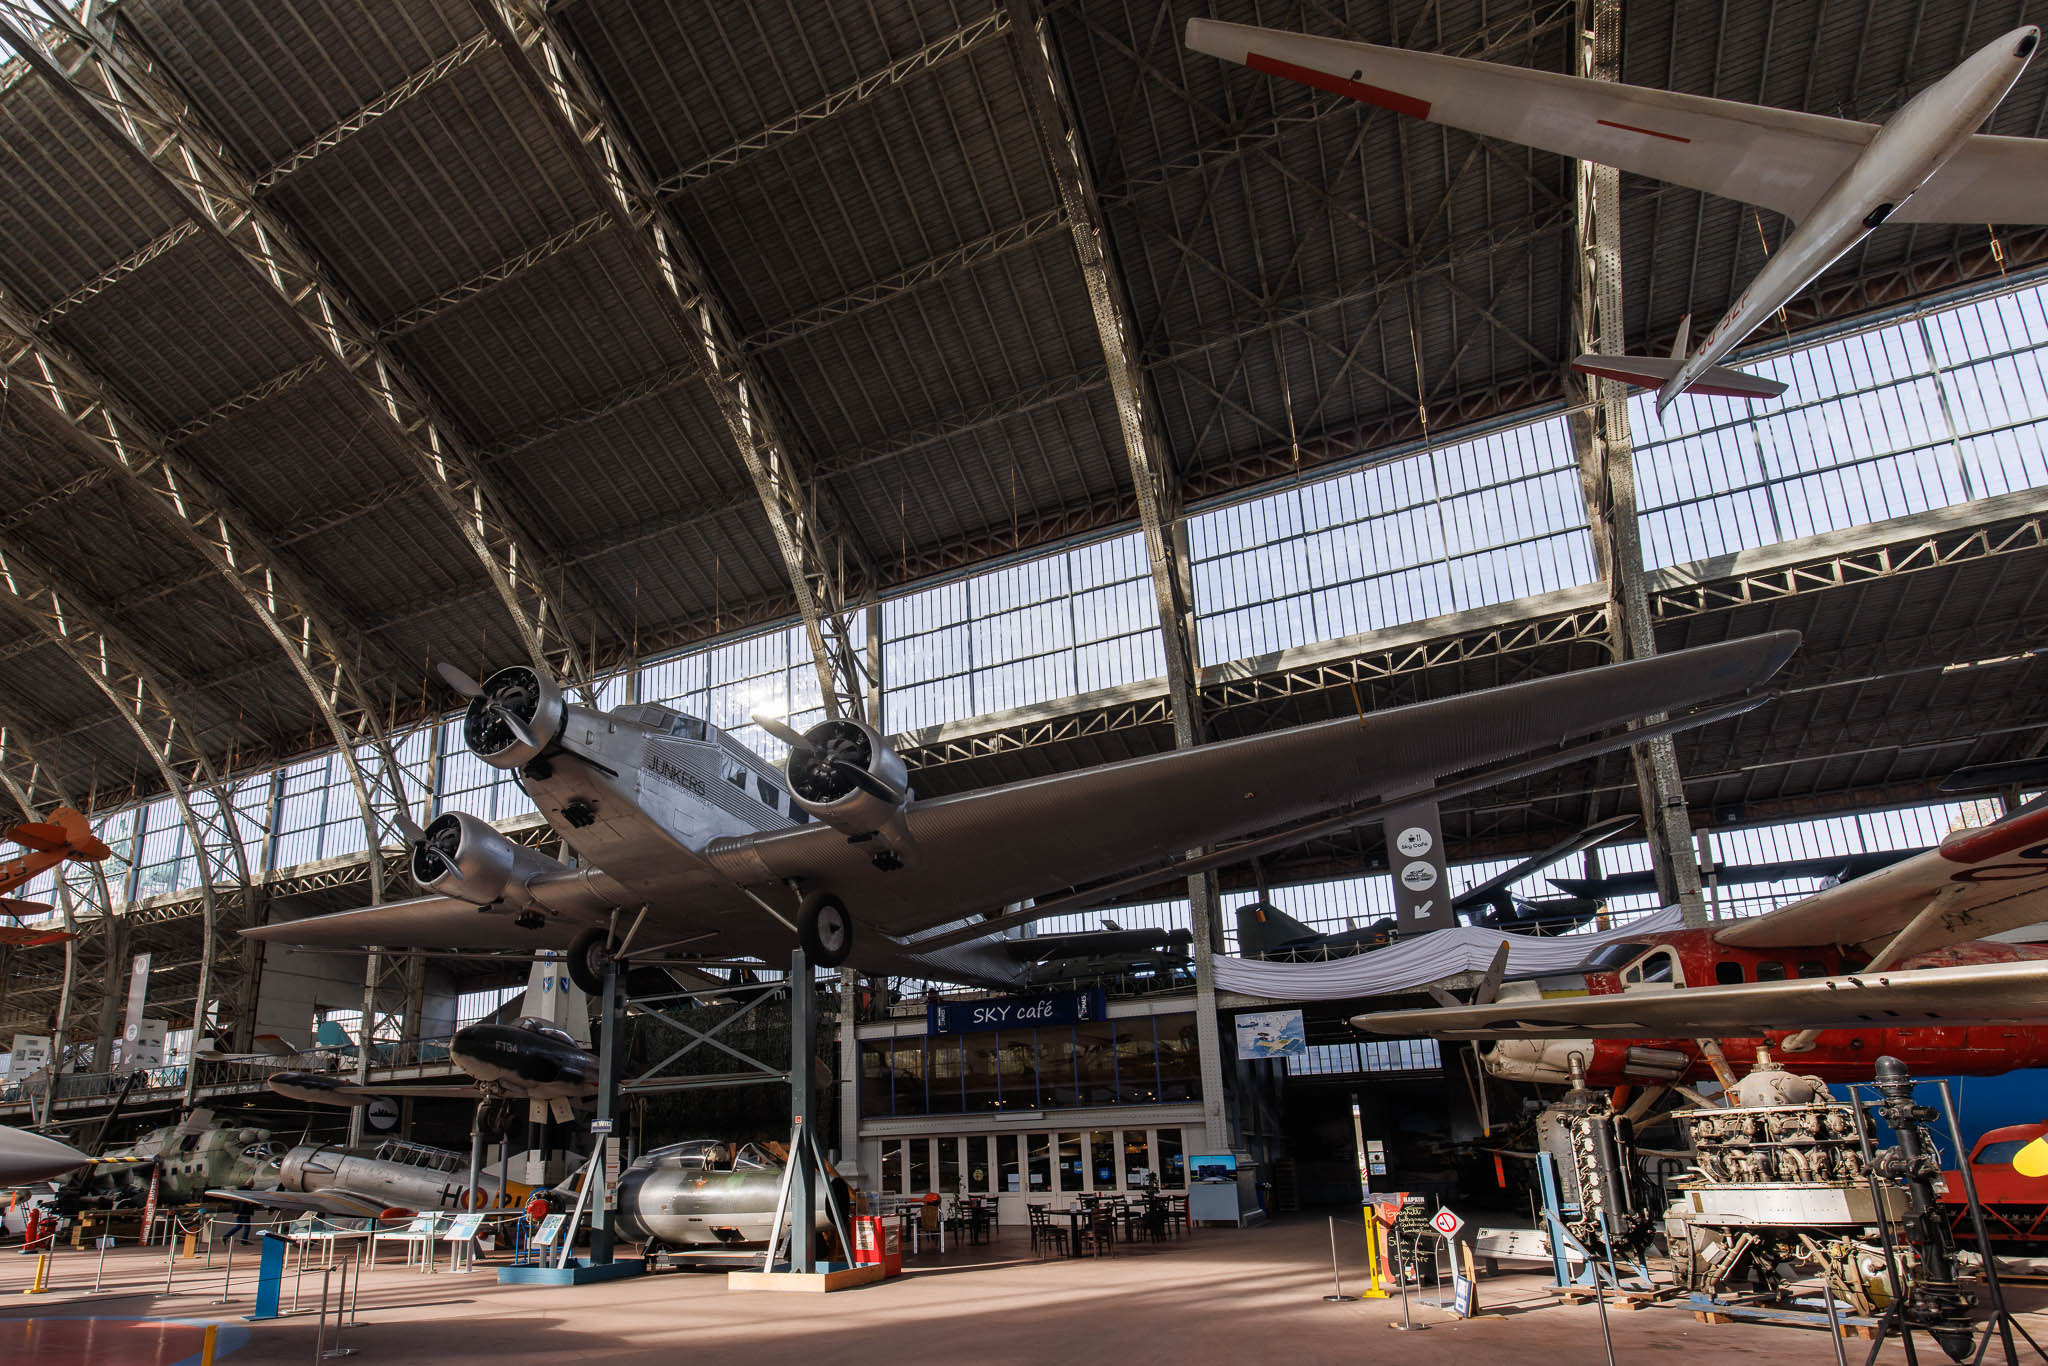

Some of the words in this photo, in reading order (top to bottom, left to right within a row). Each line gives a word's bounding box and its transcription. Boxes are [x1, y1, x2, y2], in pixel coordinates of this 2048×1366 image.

[647, 755, 706, 796] JUNKERS
[973, 1005, 1011, 1024] SKY
[1016, 1000, 1053, 1020] café
